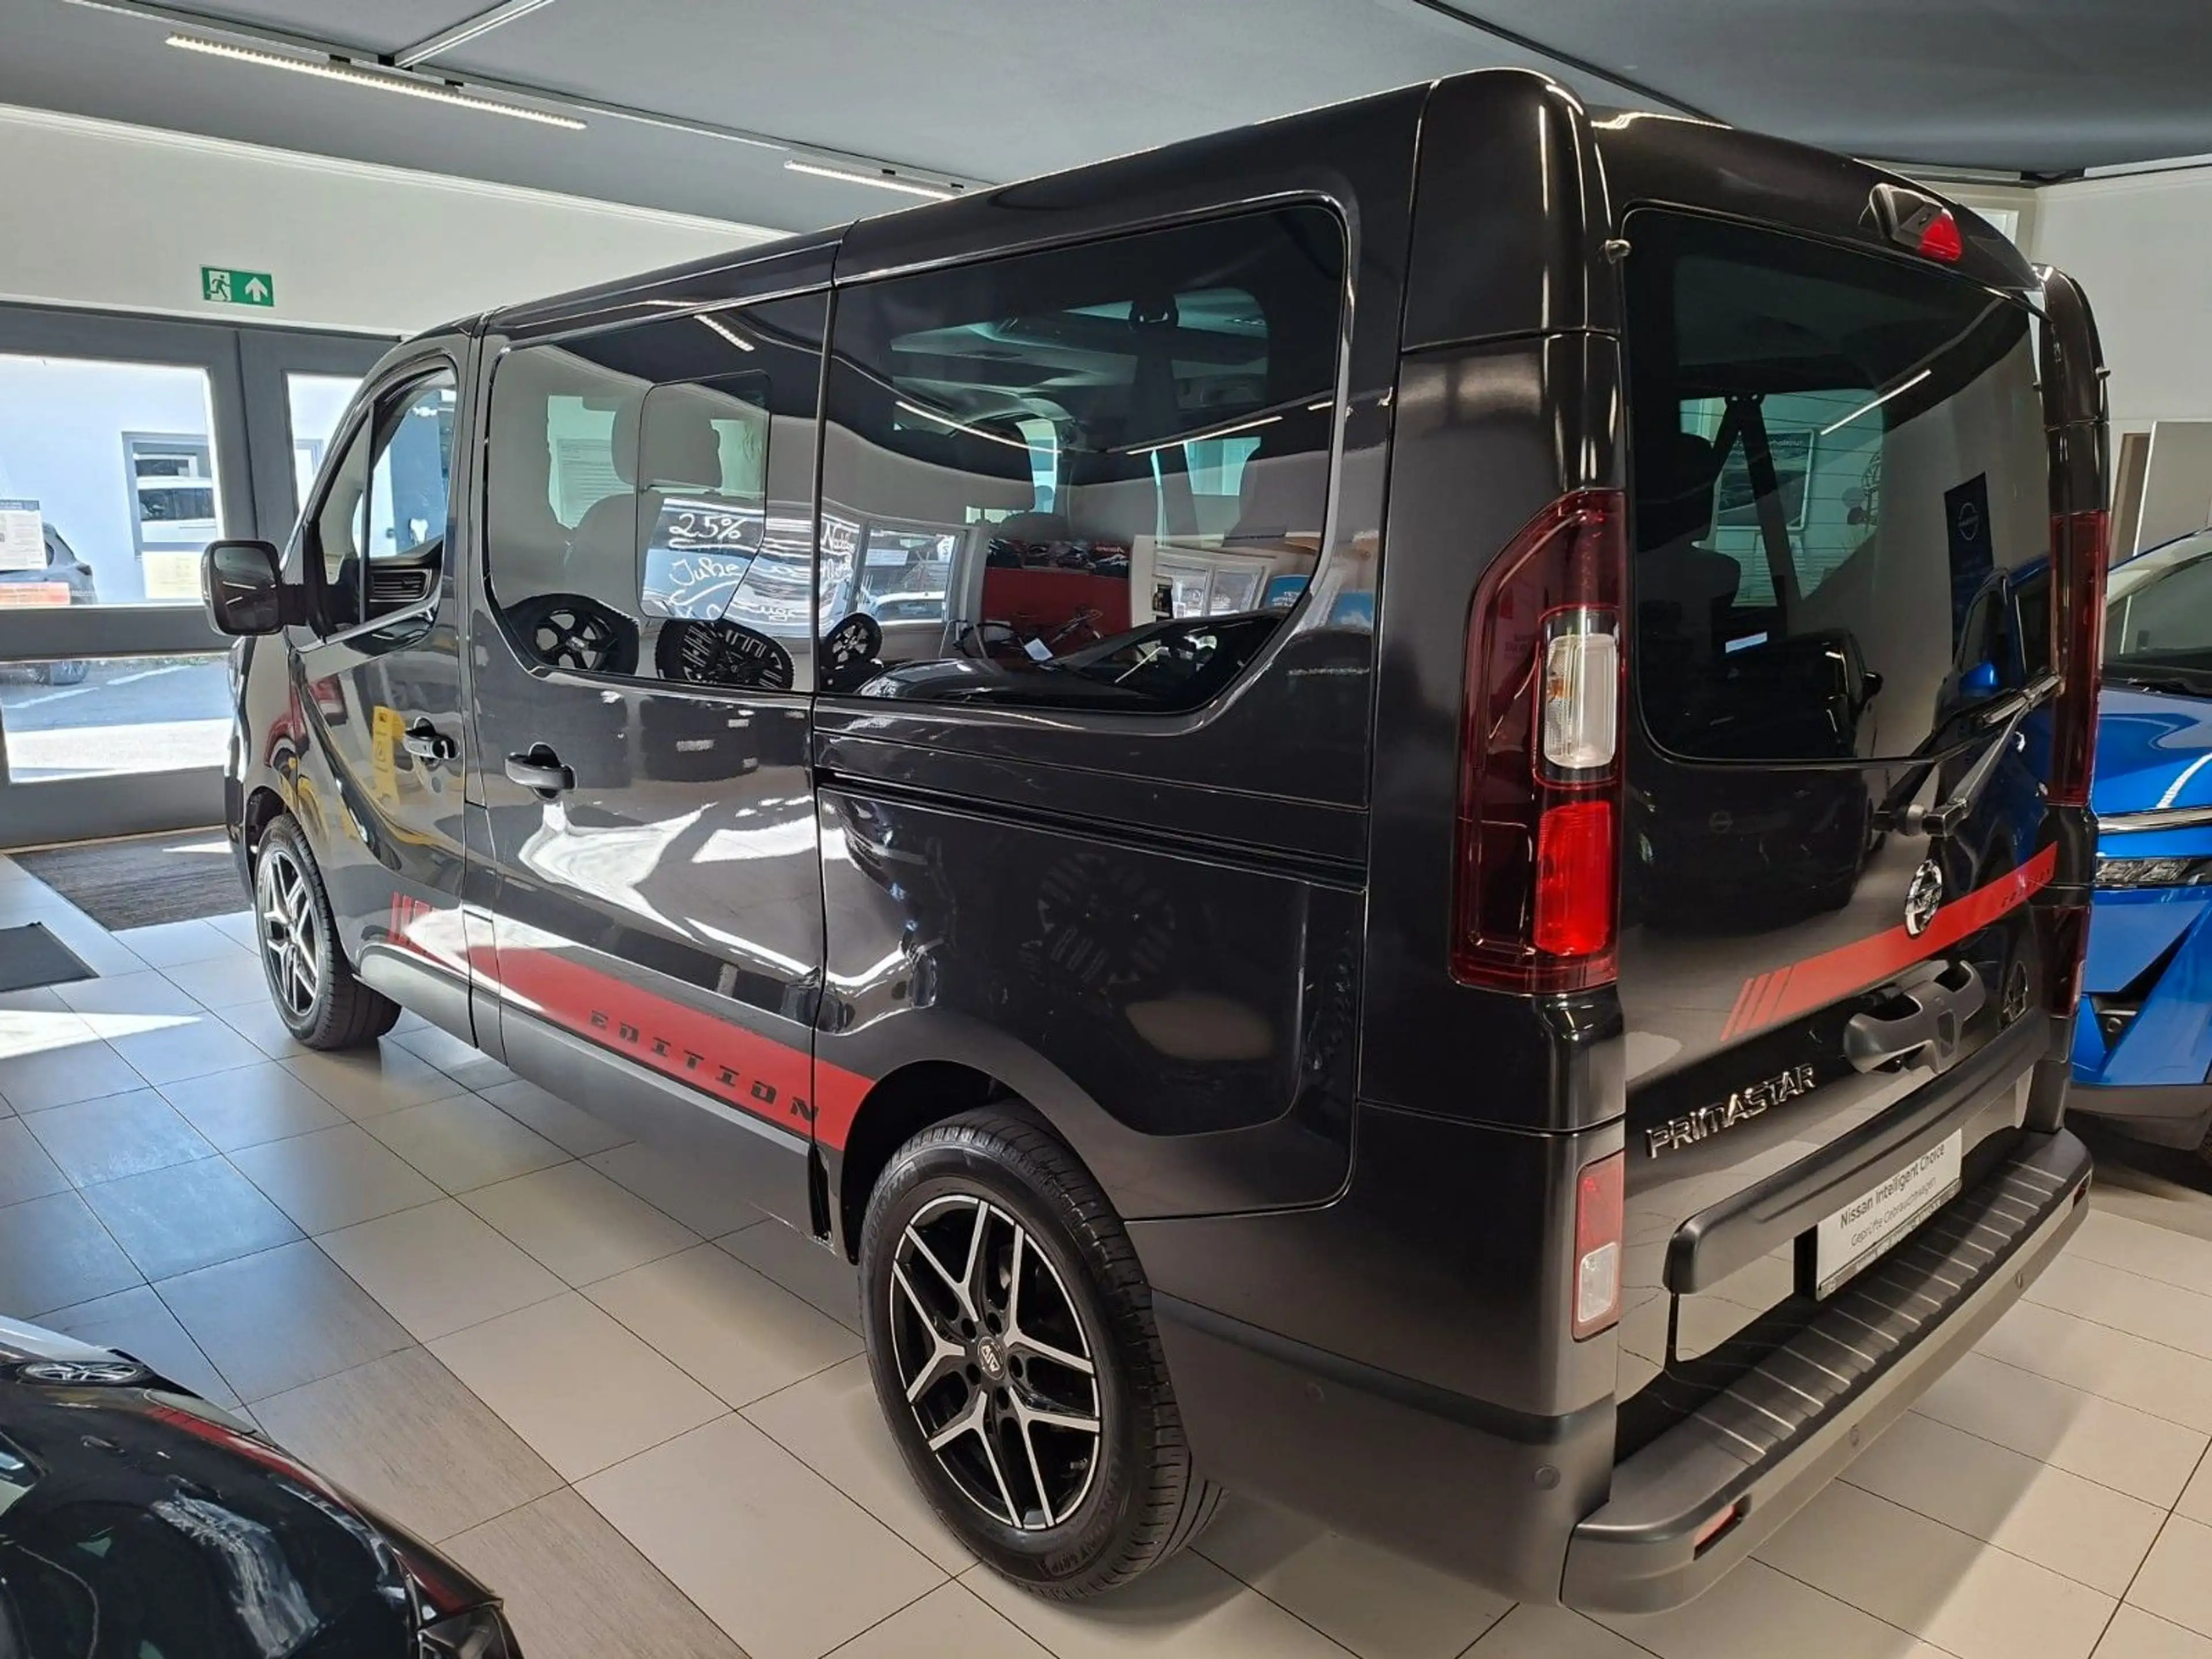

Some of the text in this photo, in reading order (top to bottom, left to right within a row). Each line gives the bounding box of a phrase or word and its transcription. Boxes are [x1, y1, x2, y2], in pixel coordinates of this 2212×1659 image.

[668, 513, 748, 540] 25%
[590, 1010, 819, 1122] EDITION
[1646, 1063, 1815, 1159] PRIMASTAR
[1840, 1196, 1873, 1228] Nissan
[1875, 1162, 1919, 1206] Intelligent
[1919, 1143, 1945, 1171] Choice
